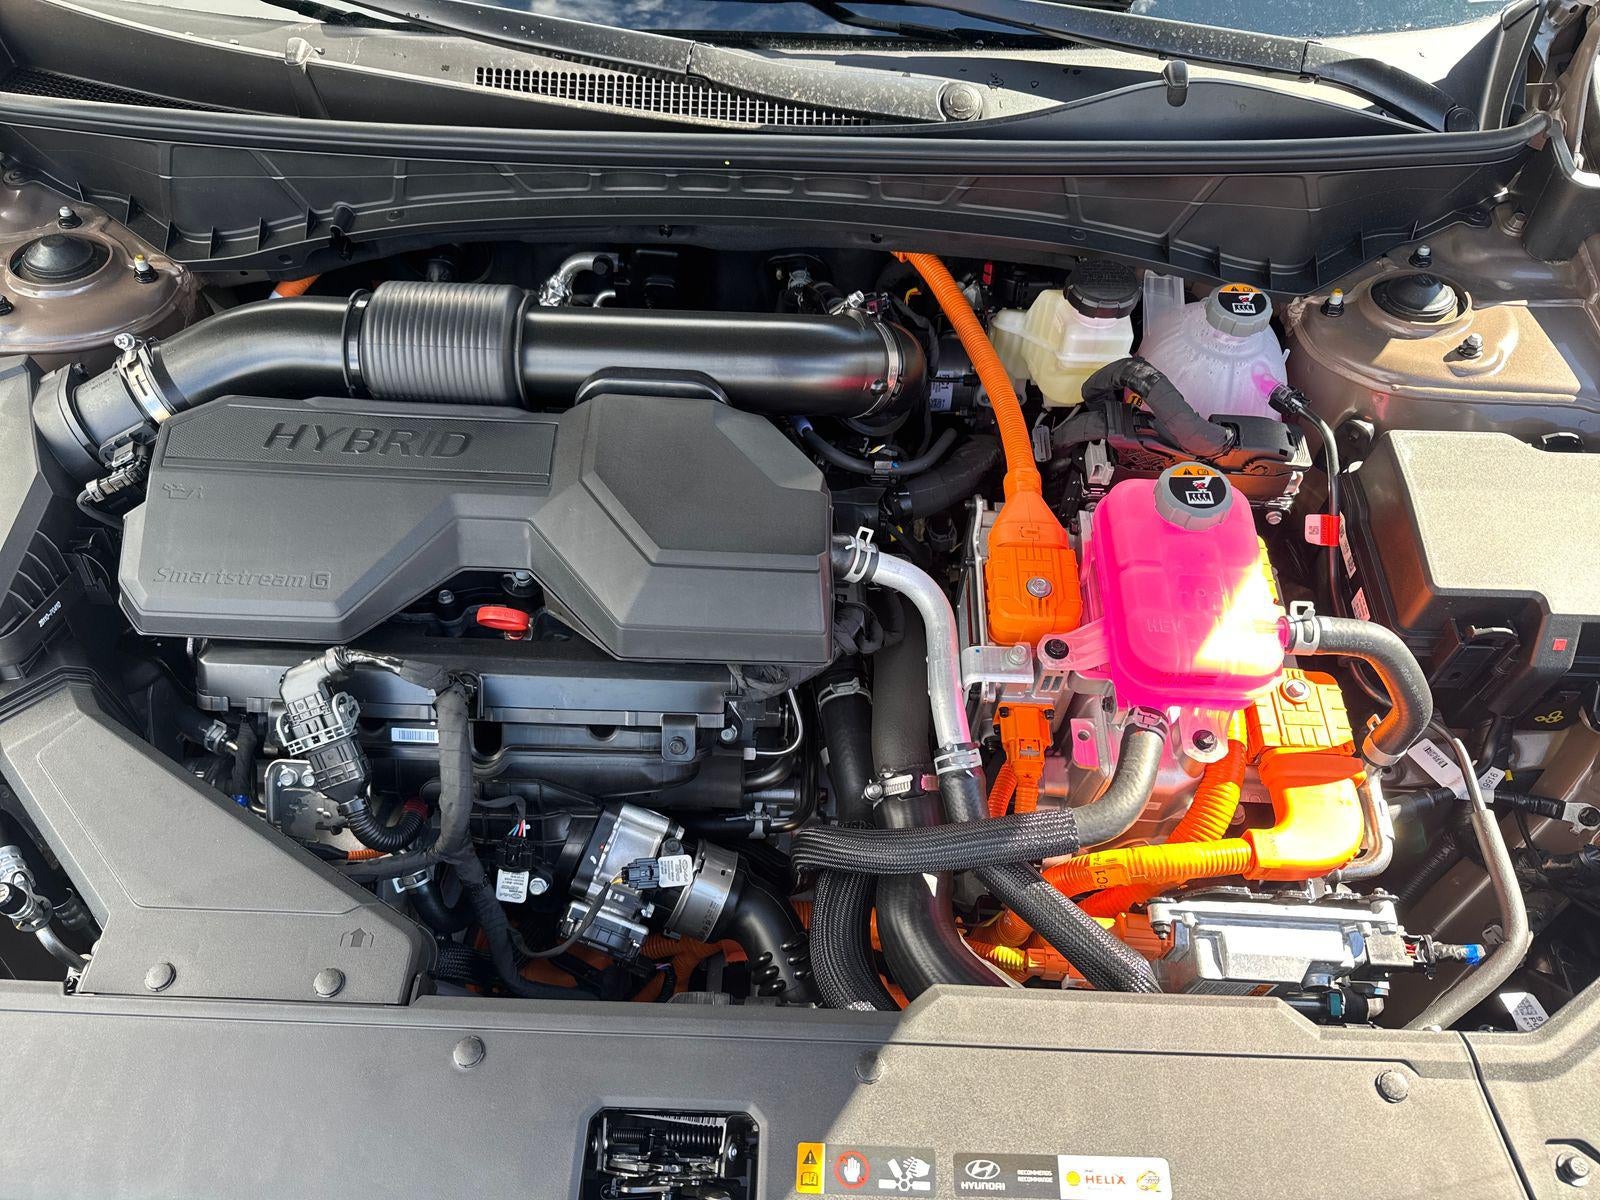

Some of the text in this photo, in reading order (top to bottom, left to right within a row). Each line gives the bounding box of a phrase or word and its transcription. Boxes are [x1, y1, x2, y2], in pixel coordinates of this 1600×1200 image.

[262, 422, 473, 458] HYBRID
[153, 567, 306, 588] Smartstream
[960, 1181, 1006, 1191] HYUNDAI
[1085, 1175, 1127, 1185] HELIX
